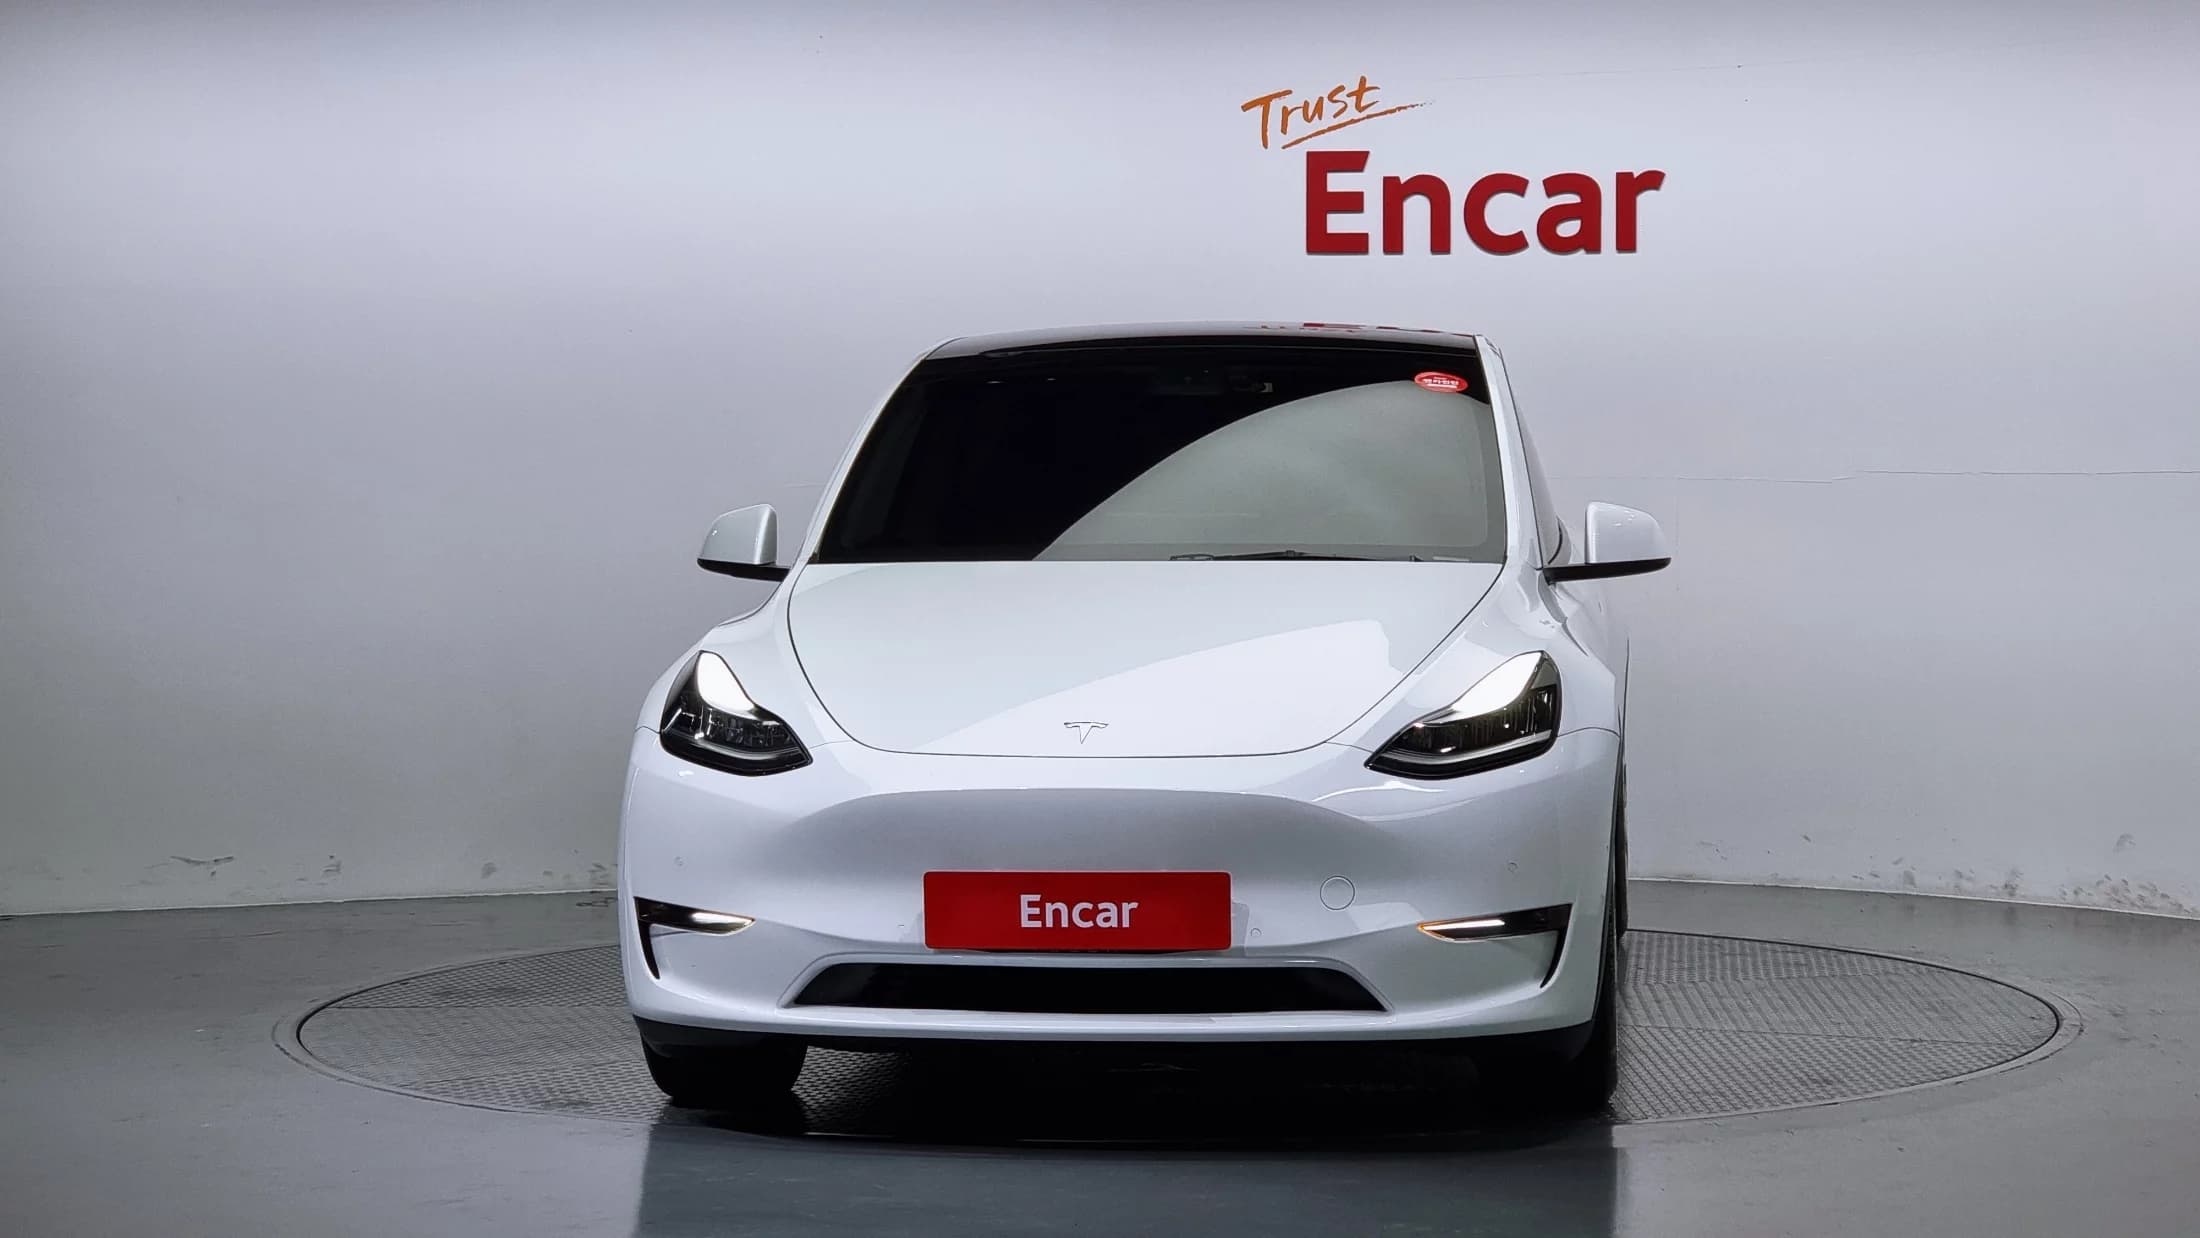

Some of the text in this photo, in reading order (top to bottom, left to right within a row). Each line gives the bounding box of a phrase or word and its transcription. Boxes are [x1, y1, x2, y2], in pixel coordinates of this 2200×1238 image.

[1241, 75, 1380, 149] Trust
[1306, 150, 1666, 255] Encar
[1019, 893, 1139, 928] Encar
